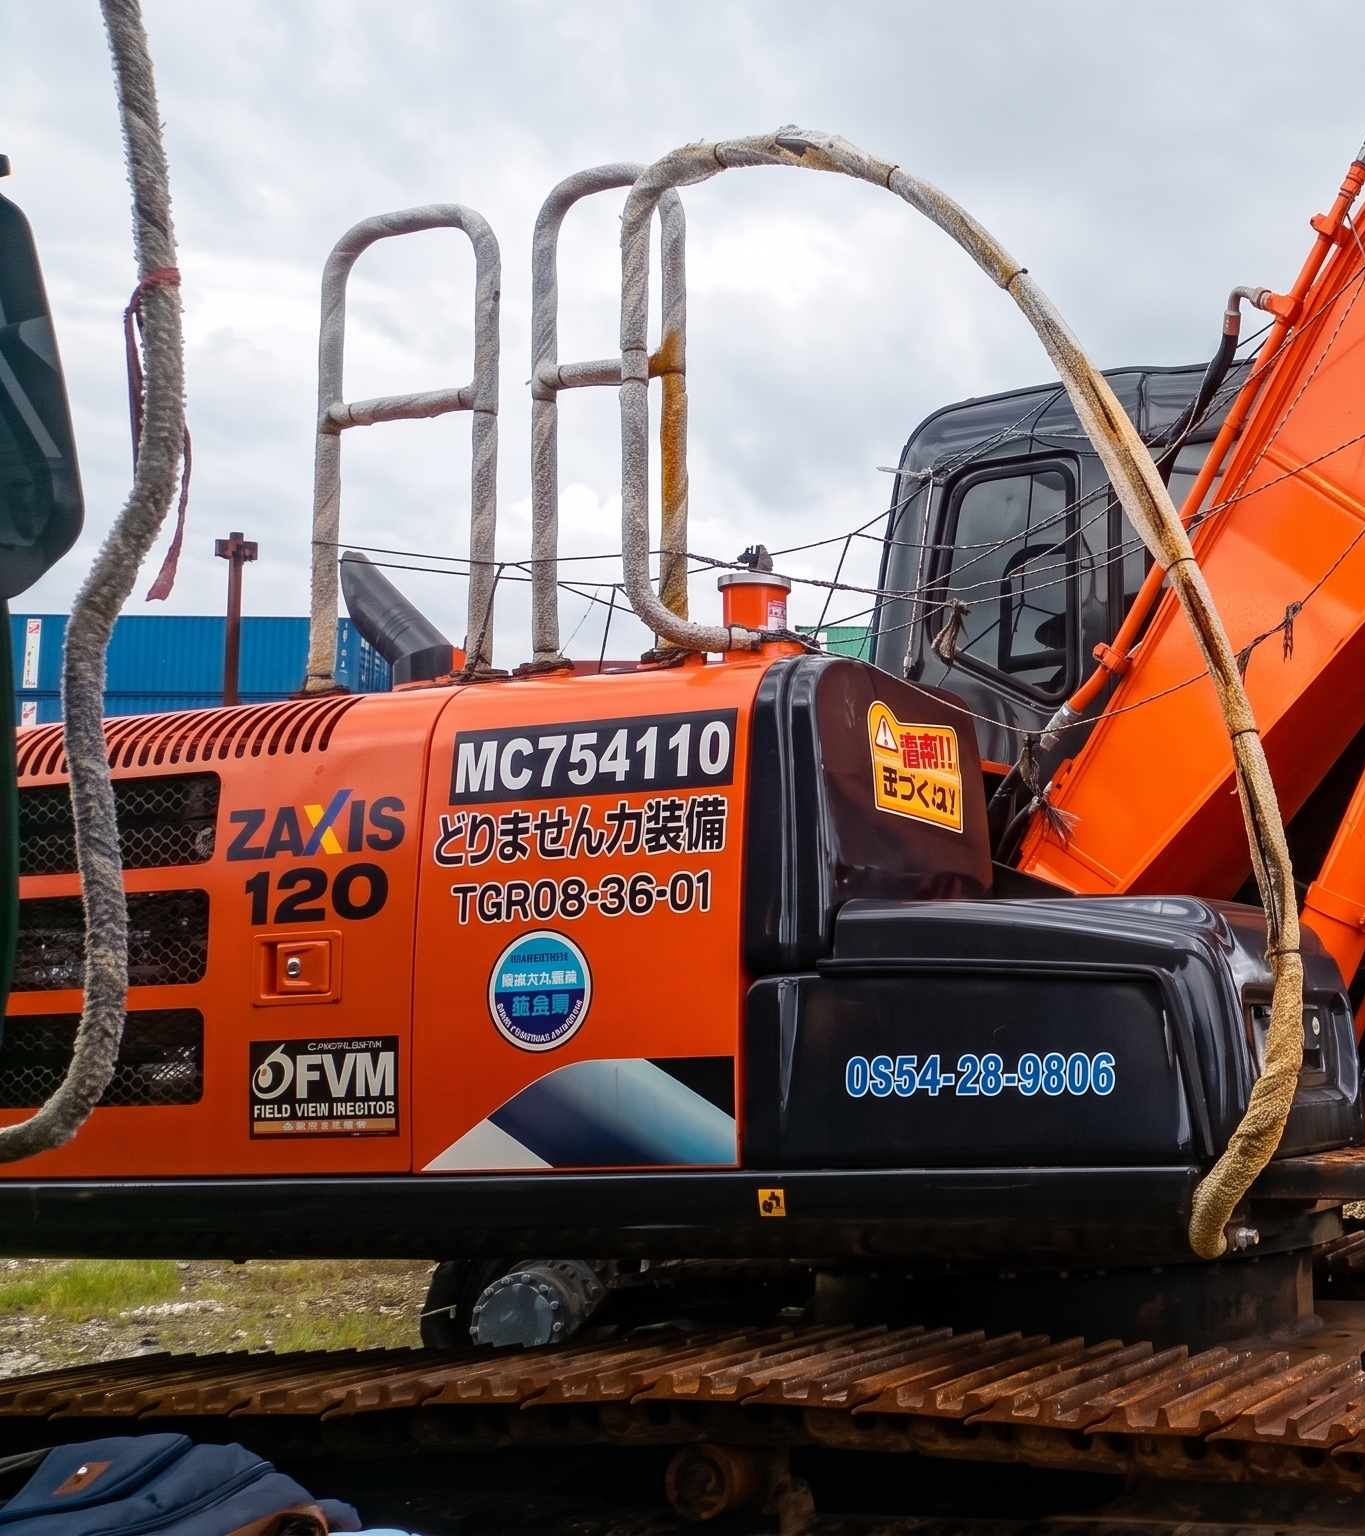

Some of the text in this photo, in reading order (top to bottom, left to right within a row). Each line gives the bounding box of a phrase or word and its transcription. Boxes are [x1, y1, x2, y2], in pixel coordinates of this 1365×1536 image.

[455, 720, 730, 794] MC754110
[226, 788, 406, 862] ZAXIS
[244, 862, 389, 926] 120
[451, 868, 713, 925] TGR08-36-01
[254, 1104, 291, 1118] FIELD
[295, 1102, 329, 1117] VIEW
